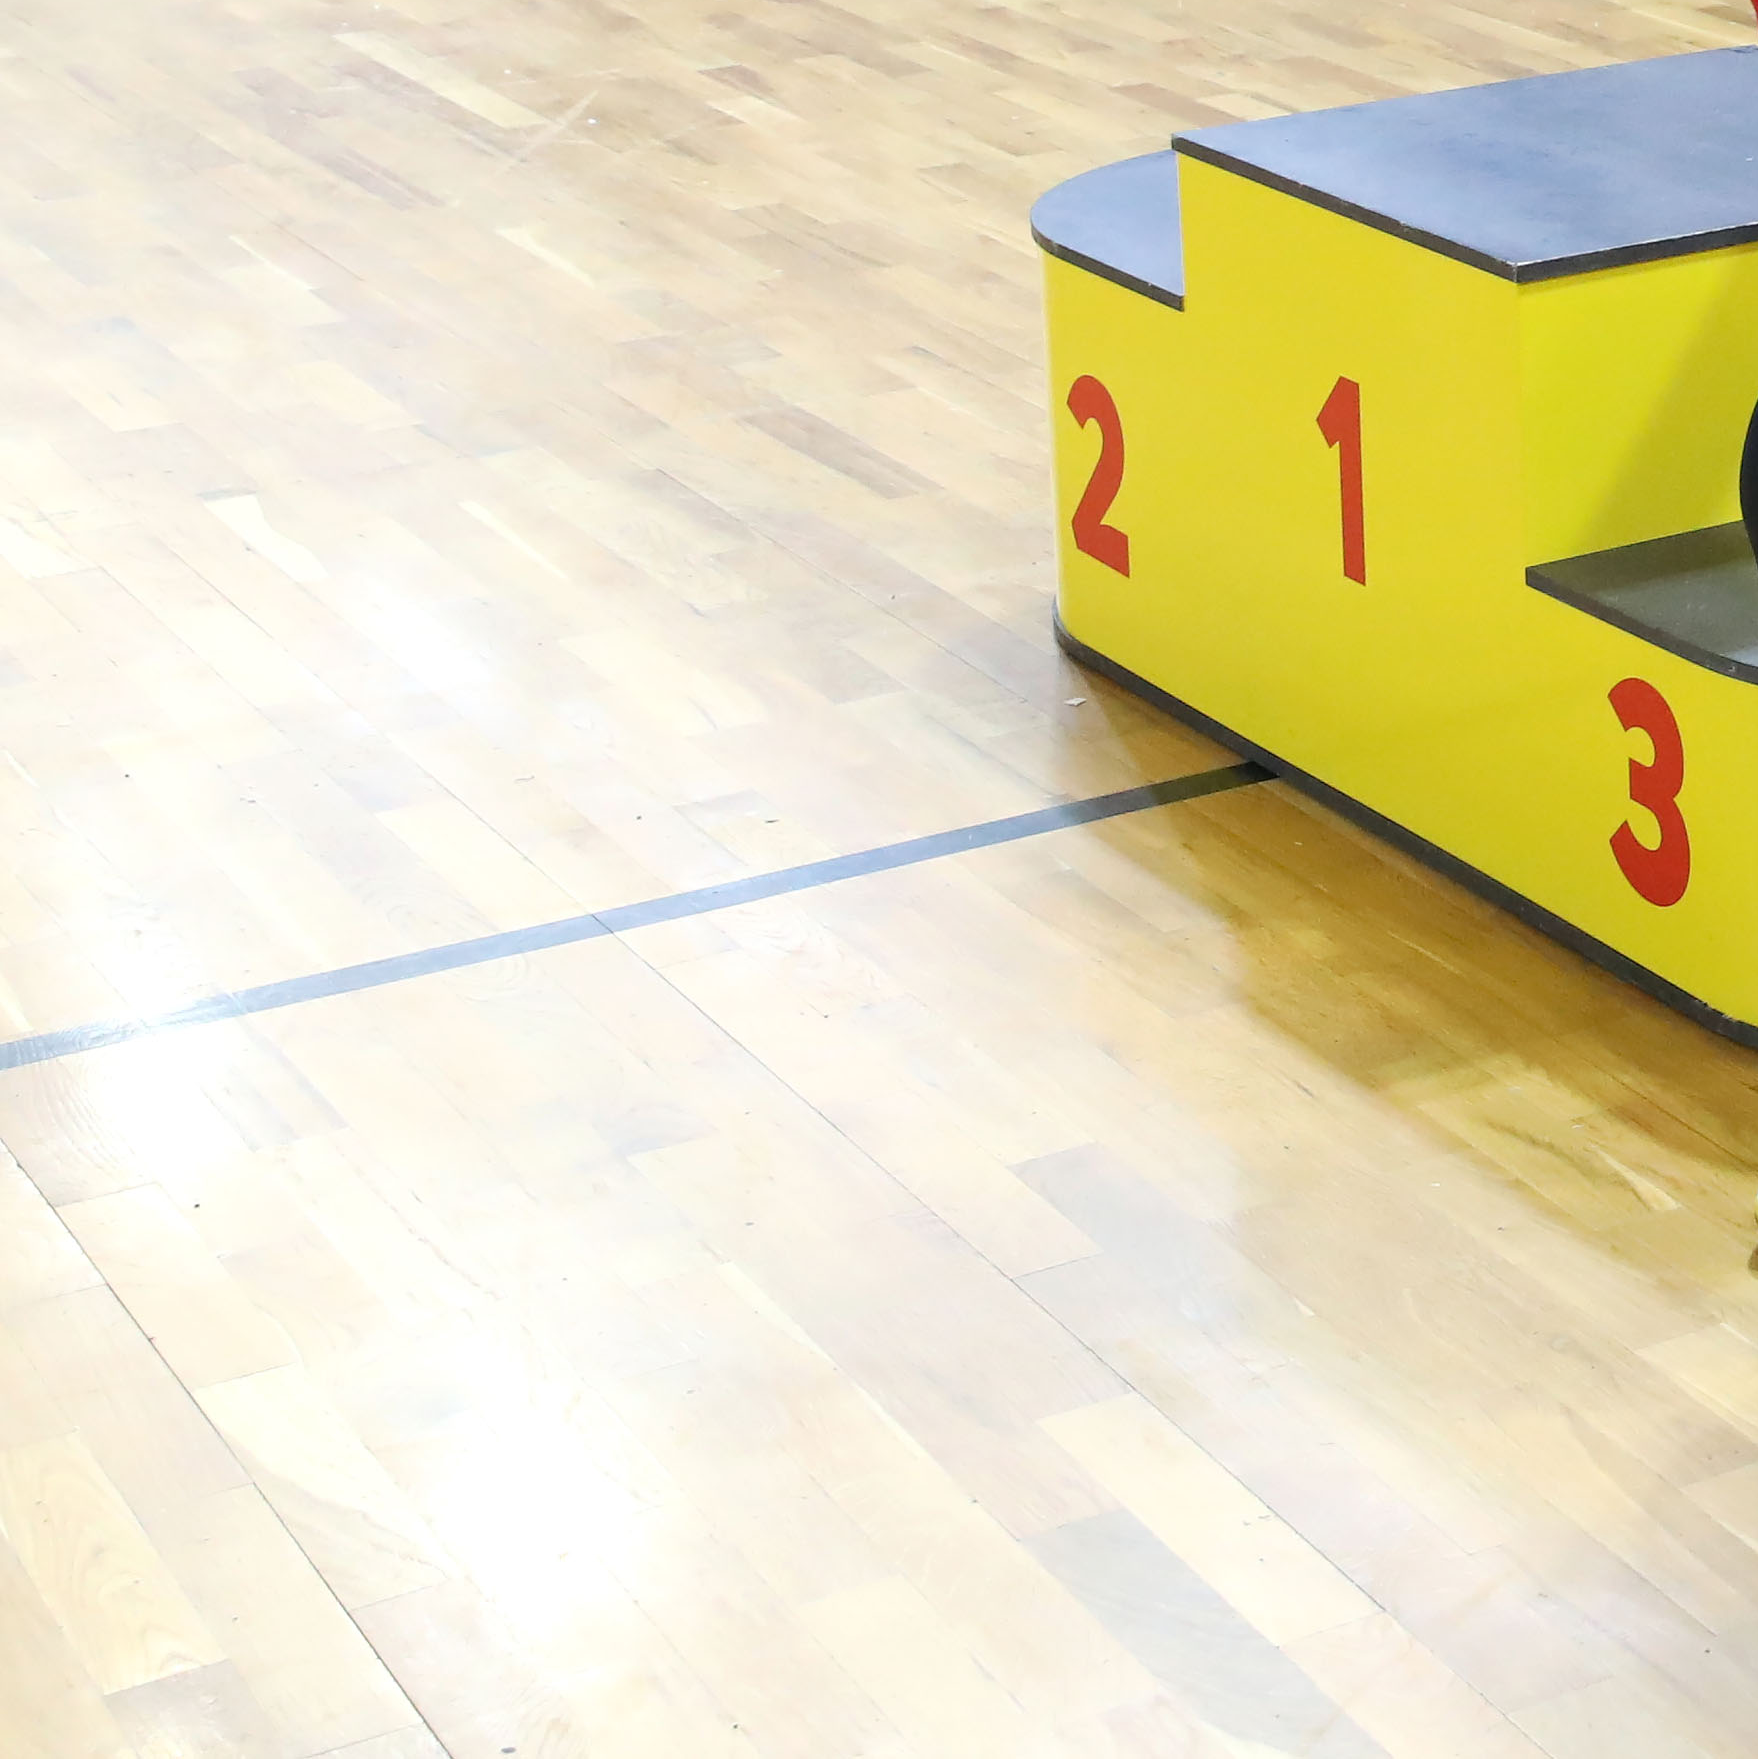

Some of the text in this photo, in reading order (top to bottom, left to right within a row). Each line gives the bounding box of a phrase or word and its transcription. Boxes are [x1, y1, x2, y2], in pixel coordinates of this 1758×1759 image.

[1066, 374, 1130, 579] 2
[1315, 375, 1366, 586] 1
[1607, 677, 1691, 908] 3
